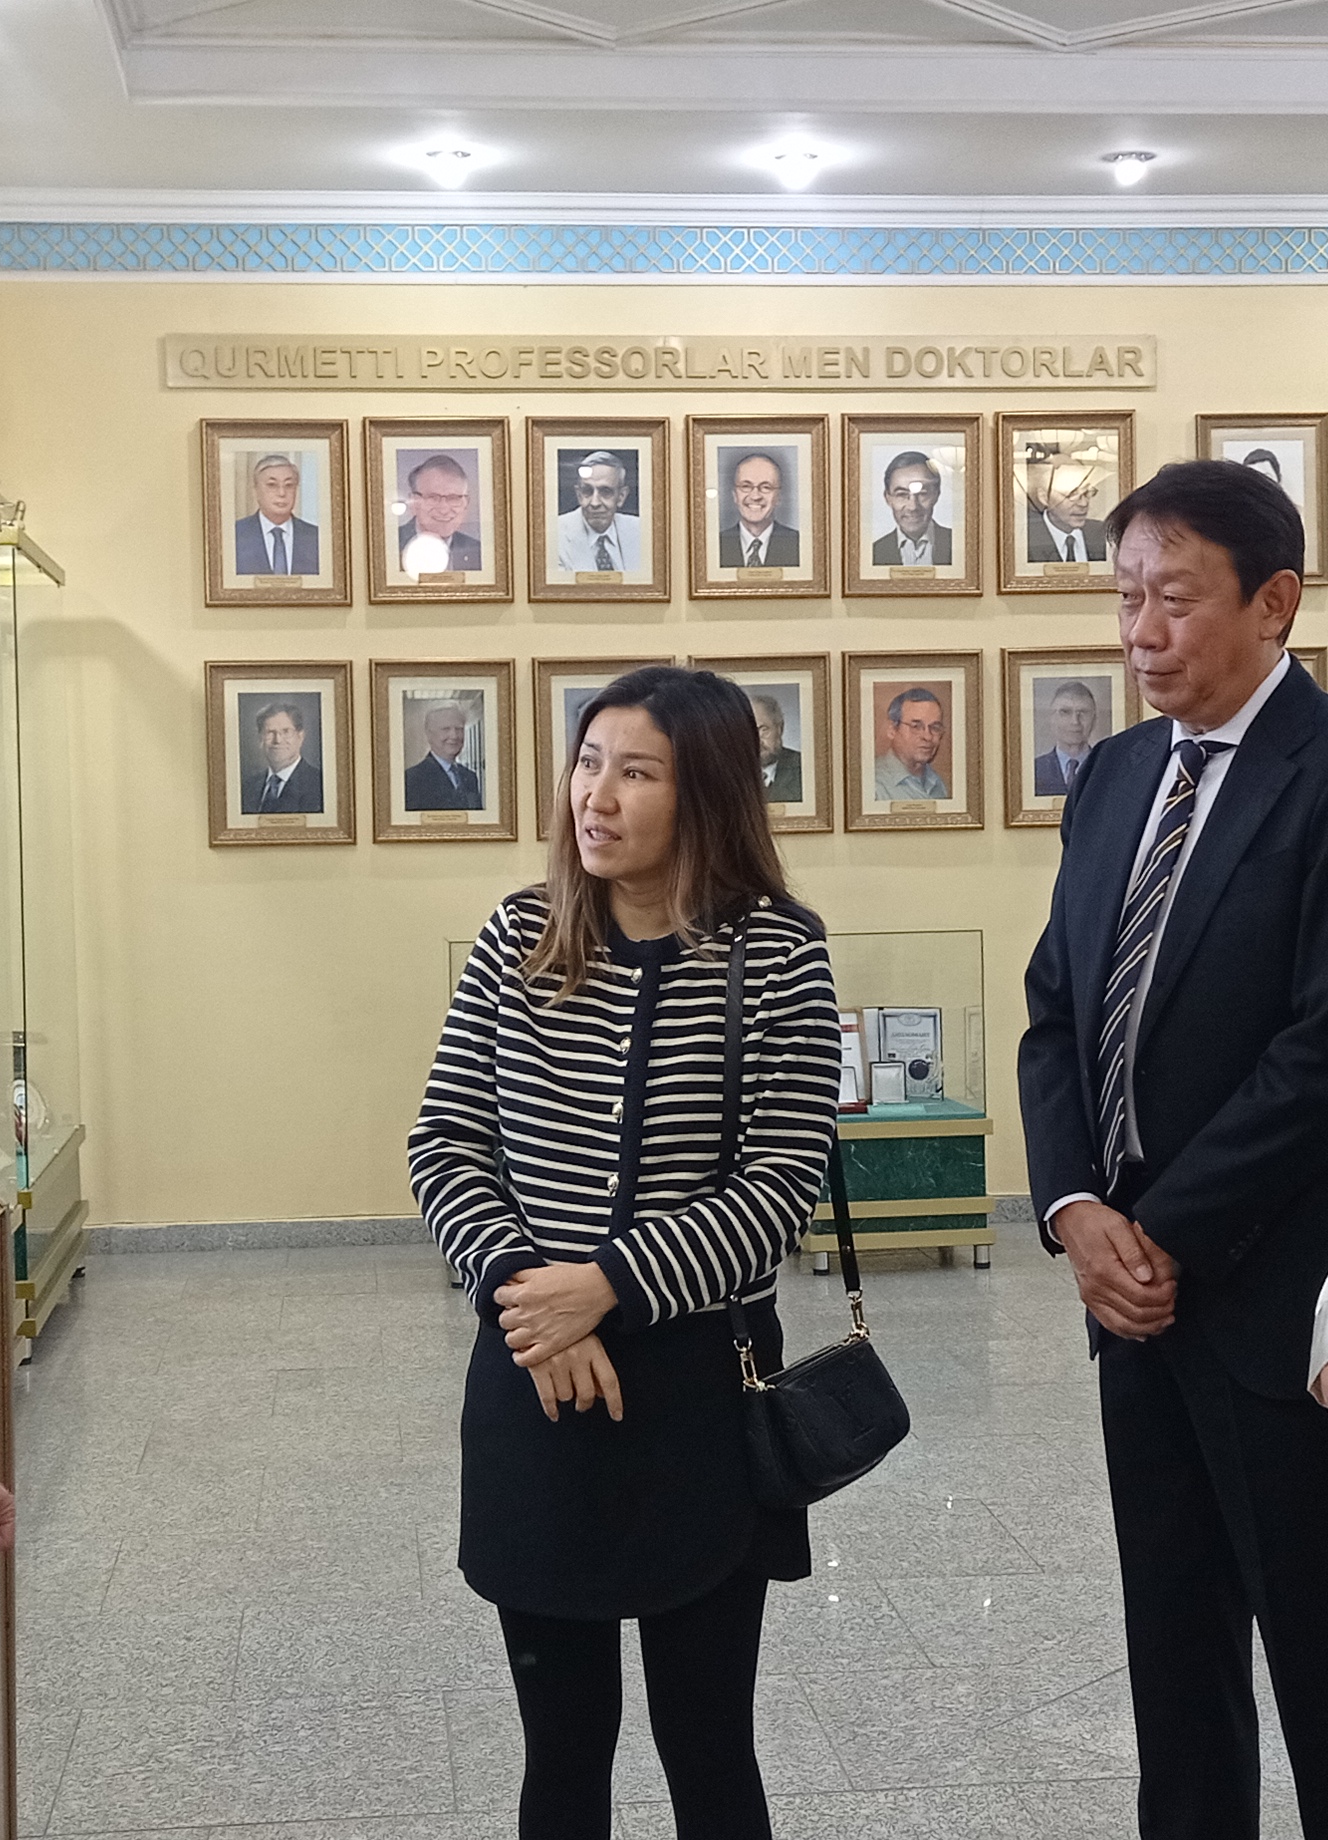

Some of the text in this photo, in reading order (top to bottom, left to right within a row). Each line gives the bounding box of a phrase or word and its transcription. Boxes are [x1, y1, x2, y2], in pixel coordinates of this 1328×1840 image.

[179, 344, 1146, 380] QURMETTI PROFESSORLAR MEN DOKTORLAR
